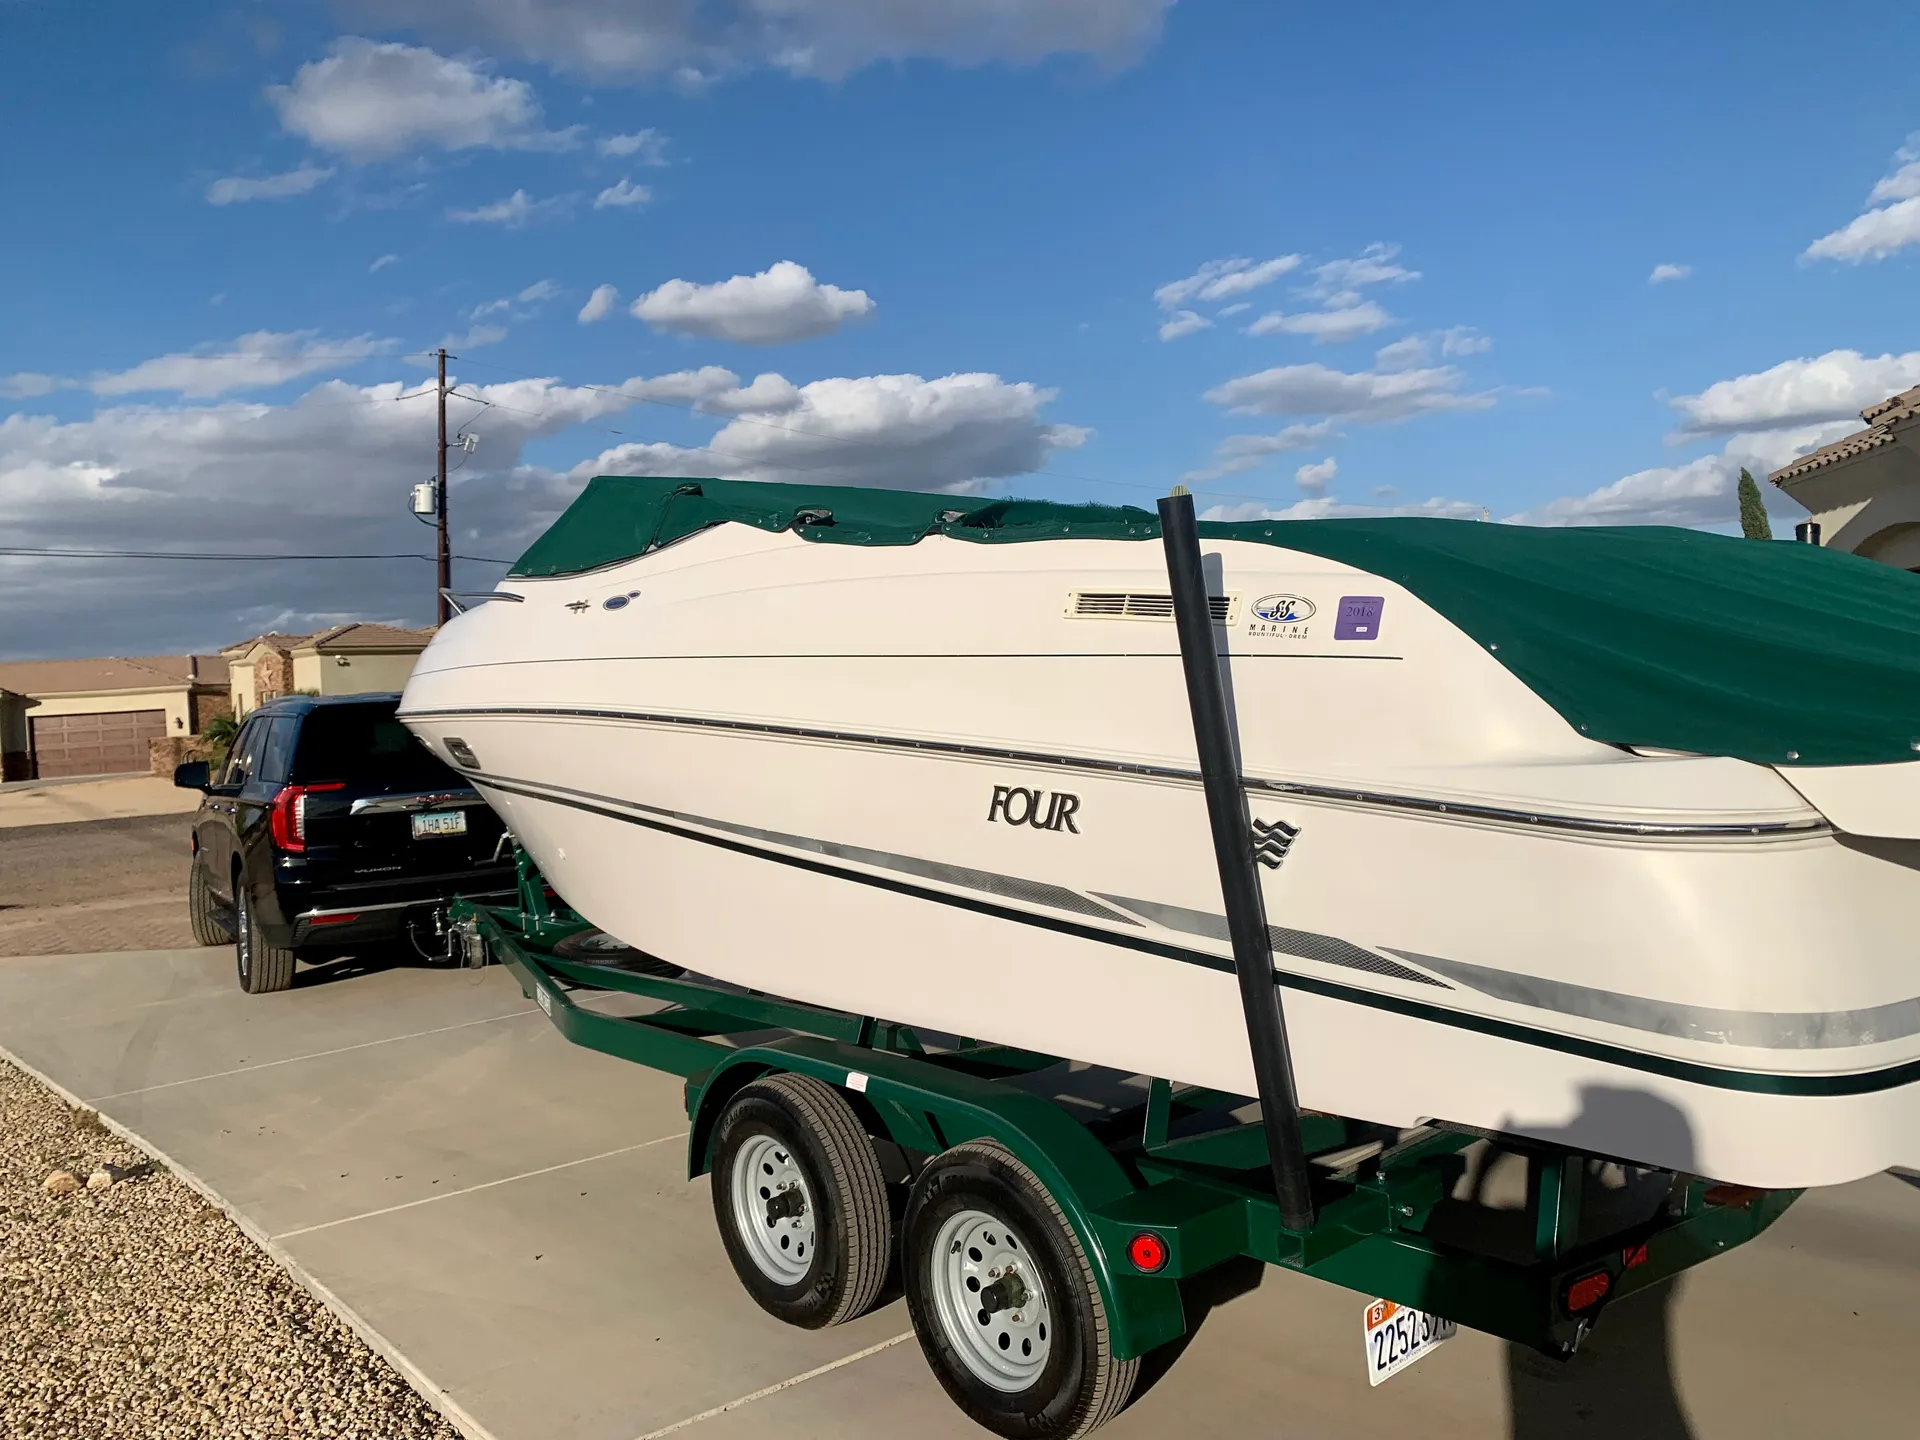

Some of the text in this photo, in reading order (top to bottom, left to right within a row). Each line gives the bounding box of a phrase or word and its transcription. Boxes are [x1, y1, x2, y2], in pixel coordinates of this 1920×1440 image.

[1346, 606, 1374, 617] 2018
[1249, 624, 1308, 635] MARINE
[986, 784, 1081, 834] FOUR
